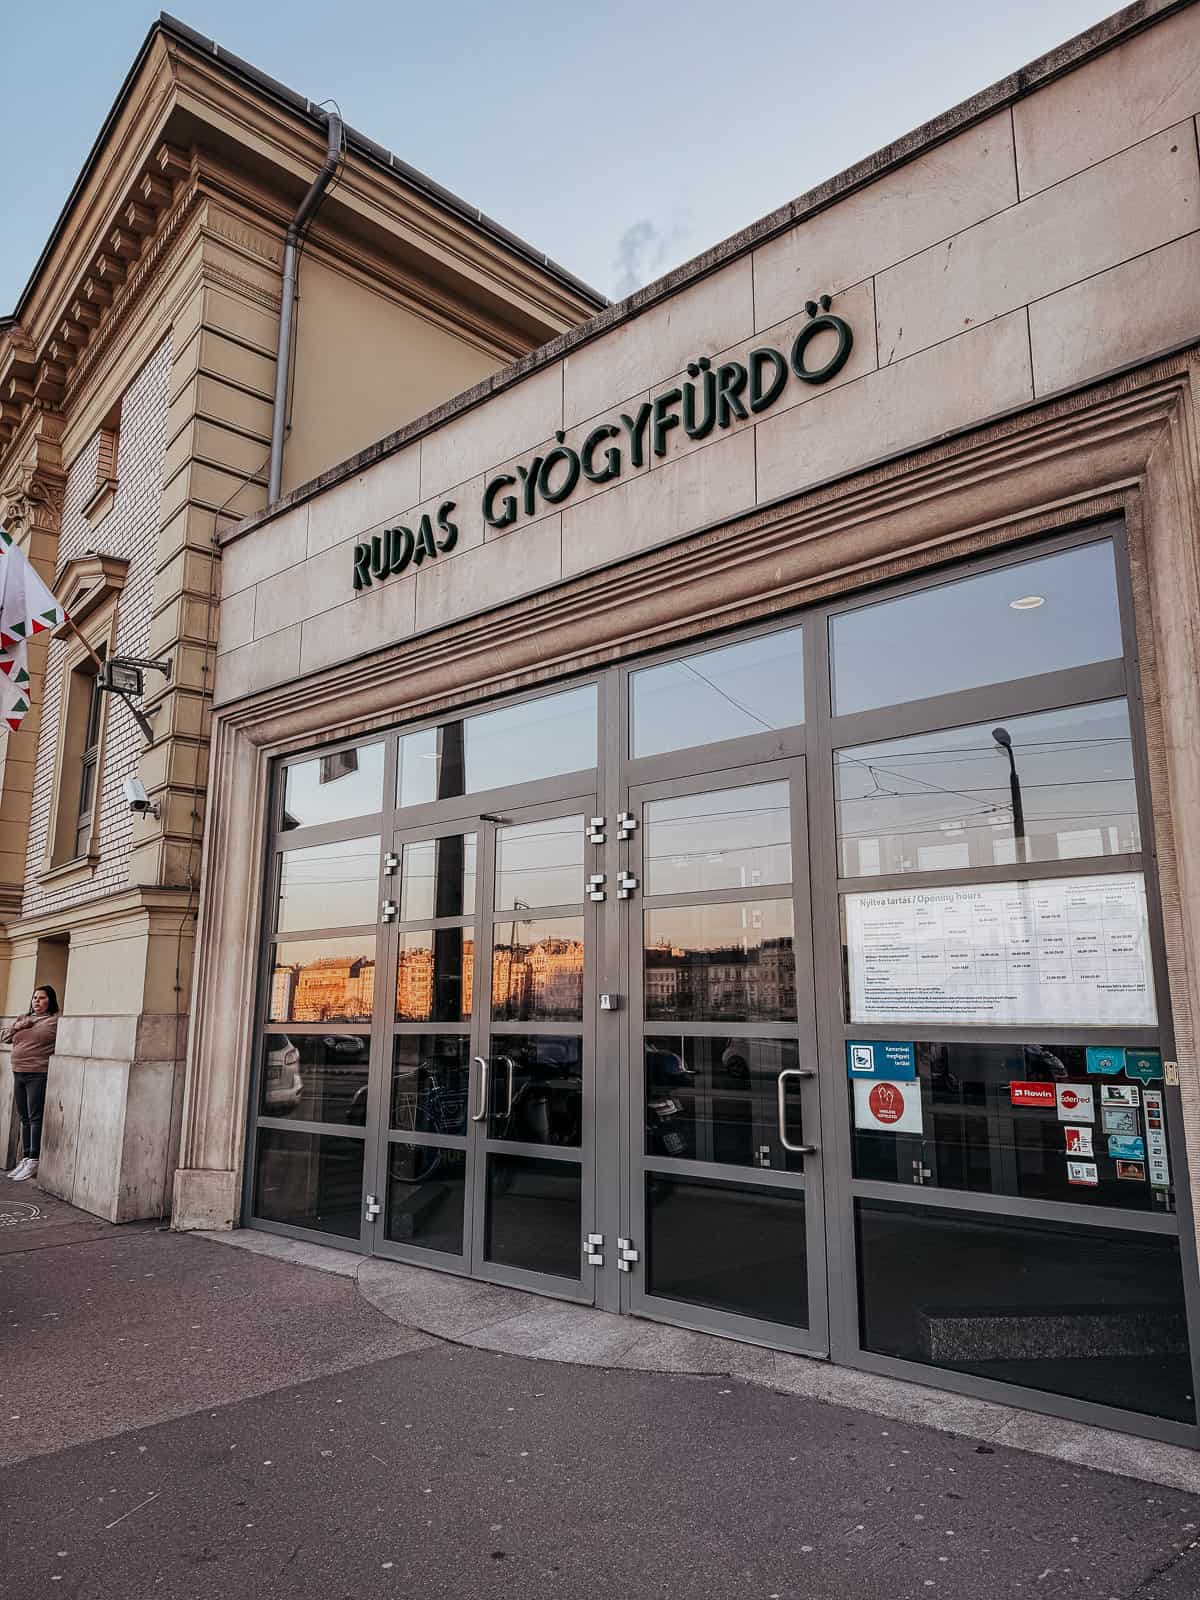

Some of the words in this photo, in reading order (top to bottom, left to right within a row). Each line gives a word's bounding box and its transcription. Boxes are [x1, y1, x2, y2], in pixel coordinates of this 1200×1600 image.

[353, 500, 458, 590] RUDAS
[918, 893, 954, 904] Opening
[956, 892, 982, 901] hours
